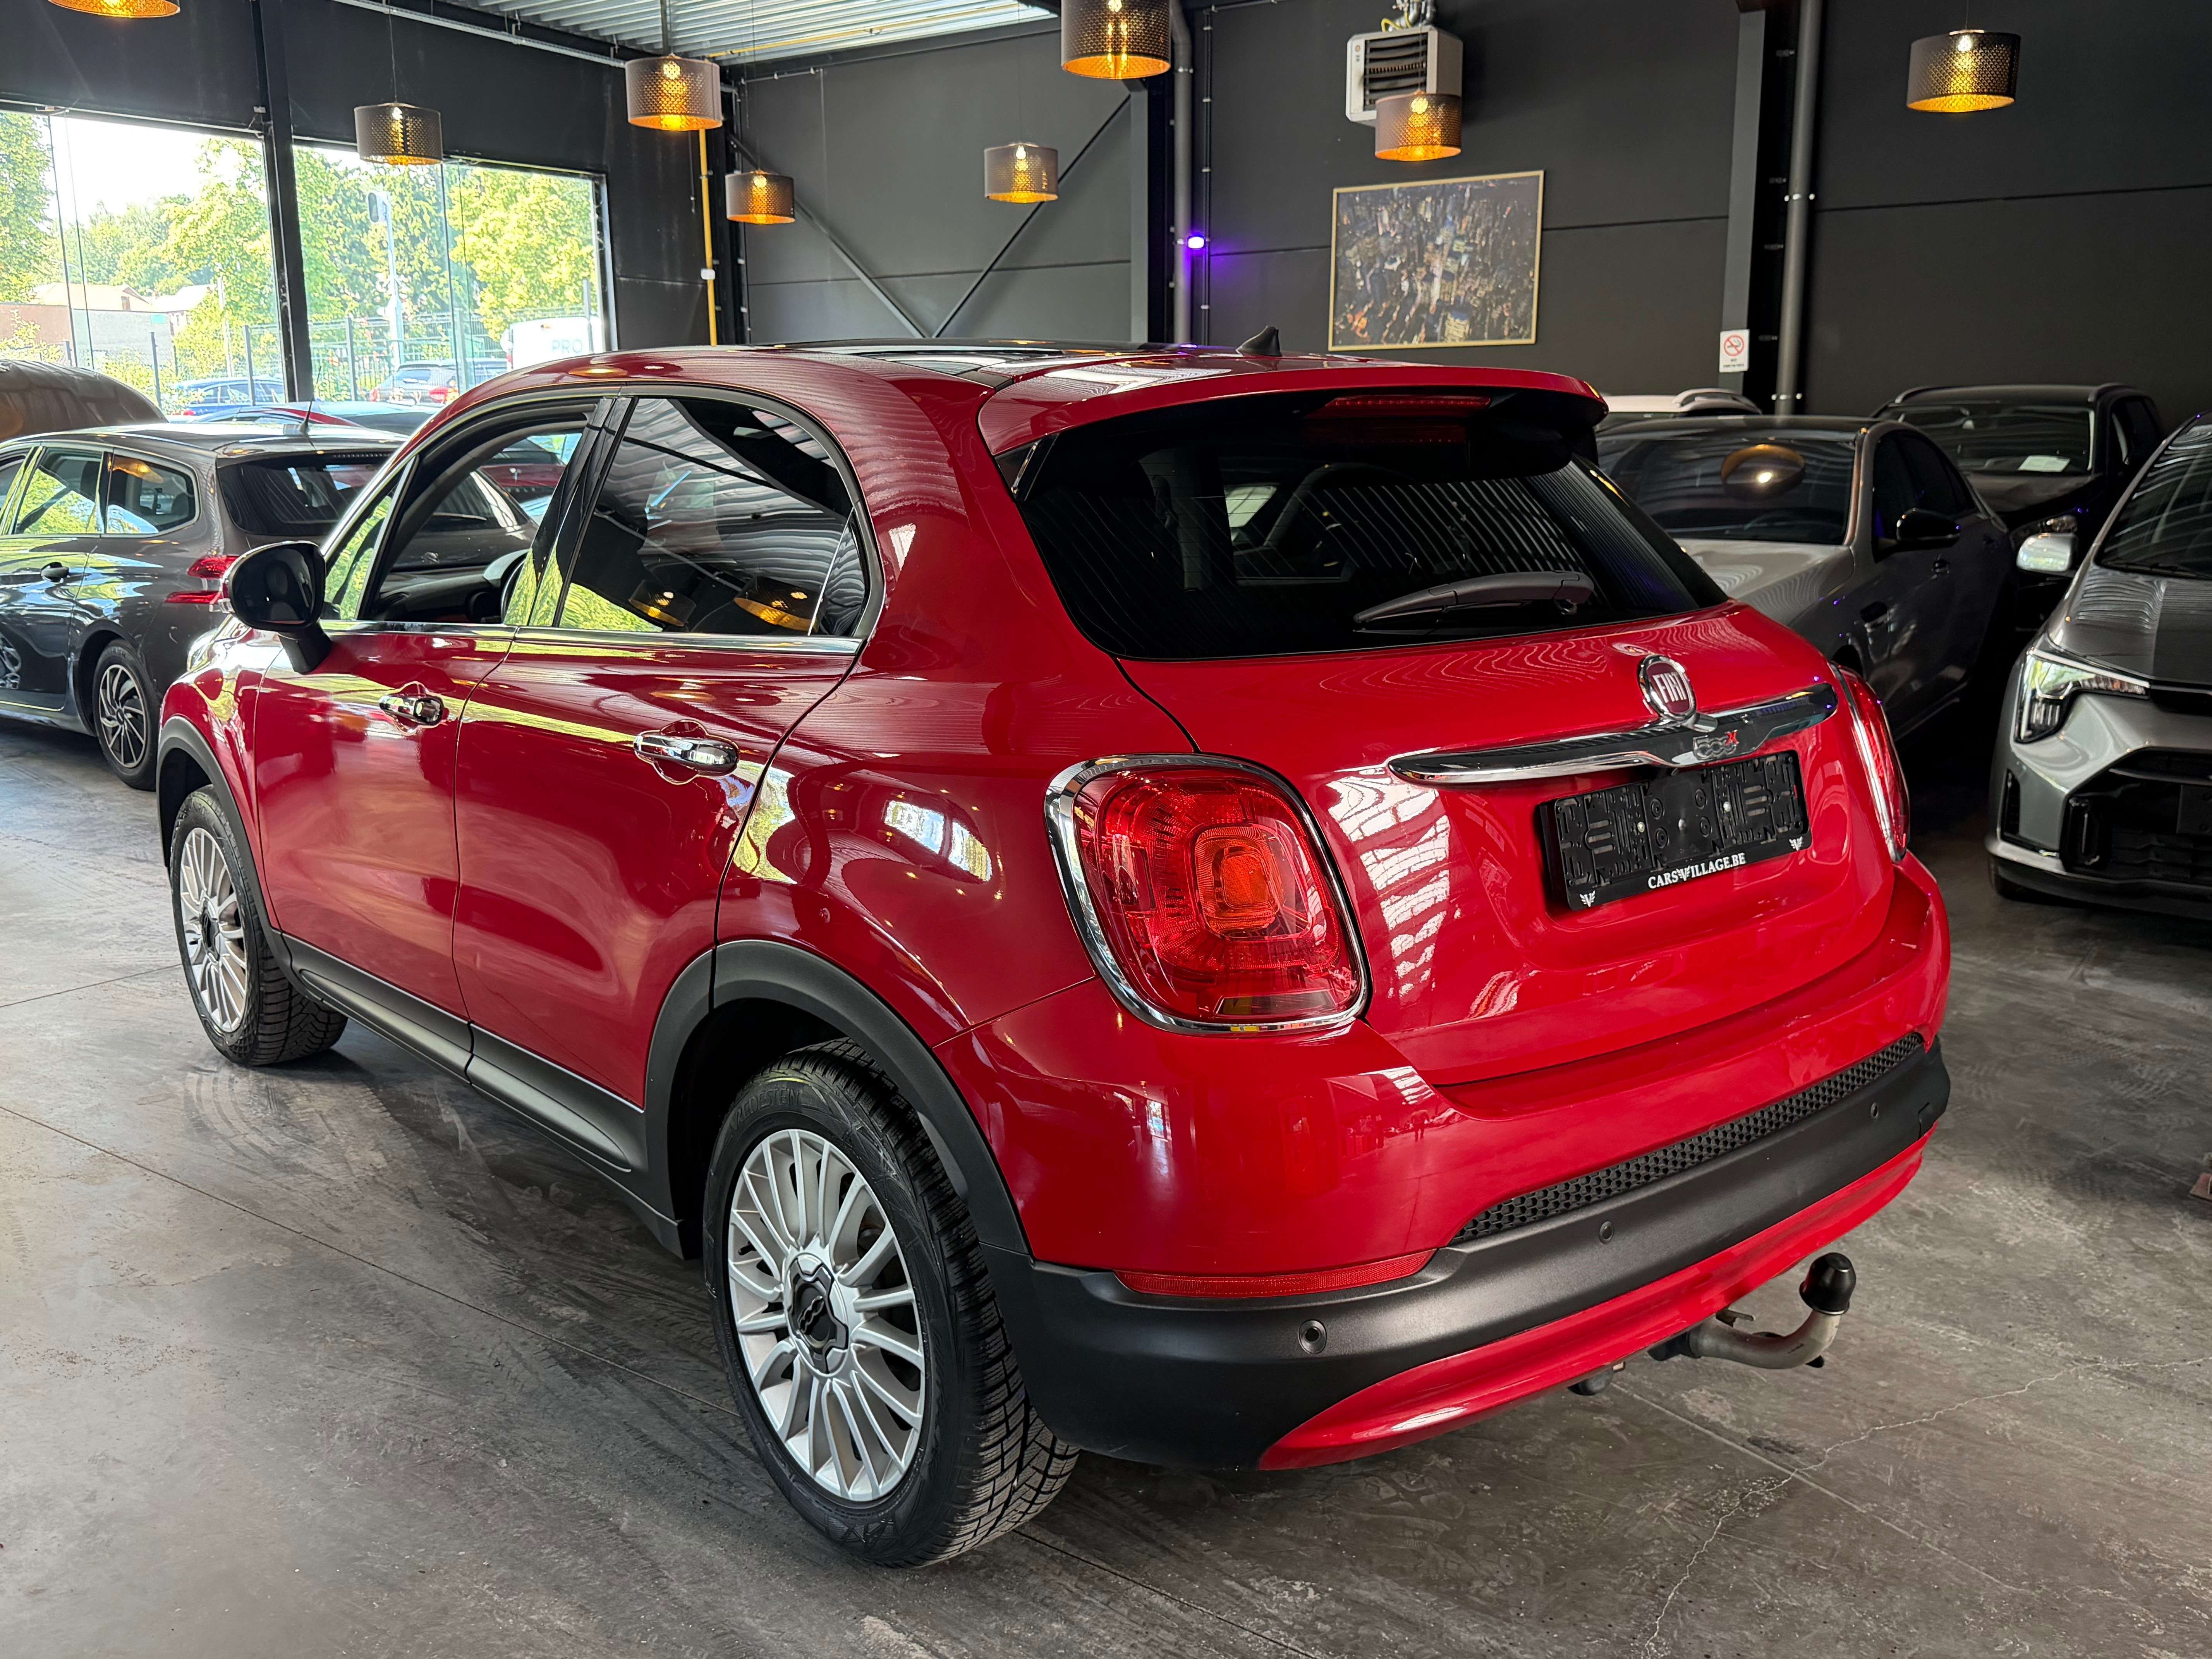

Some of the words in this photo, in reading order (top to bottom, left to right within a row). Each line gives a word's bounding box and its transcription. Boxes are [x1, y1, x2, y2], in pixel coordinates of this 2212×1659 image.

[553, 339, 582, 354] PRO
[1652, 672, 1687, 703] FIAT
[1648, 852, 1747, 889] CARSVILLAGE.BE
[729, 1087, 800, 1131] VREDESTEIN
